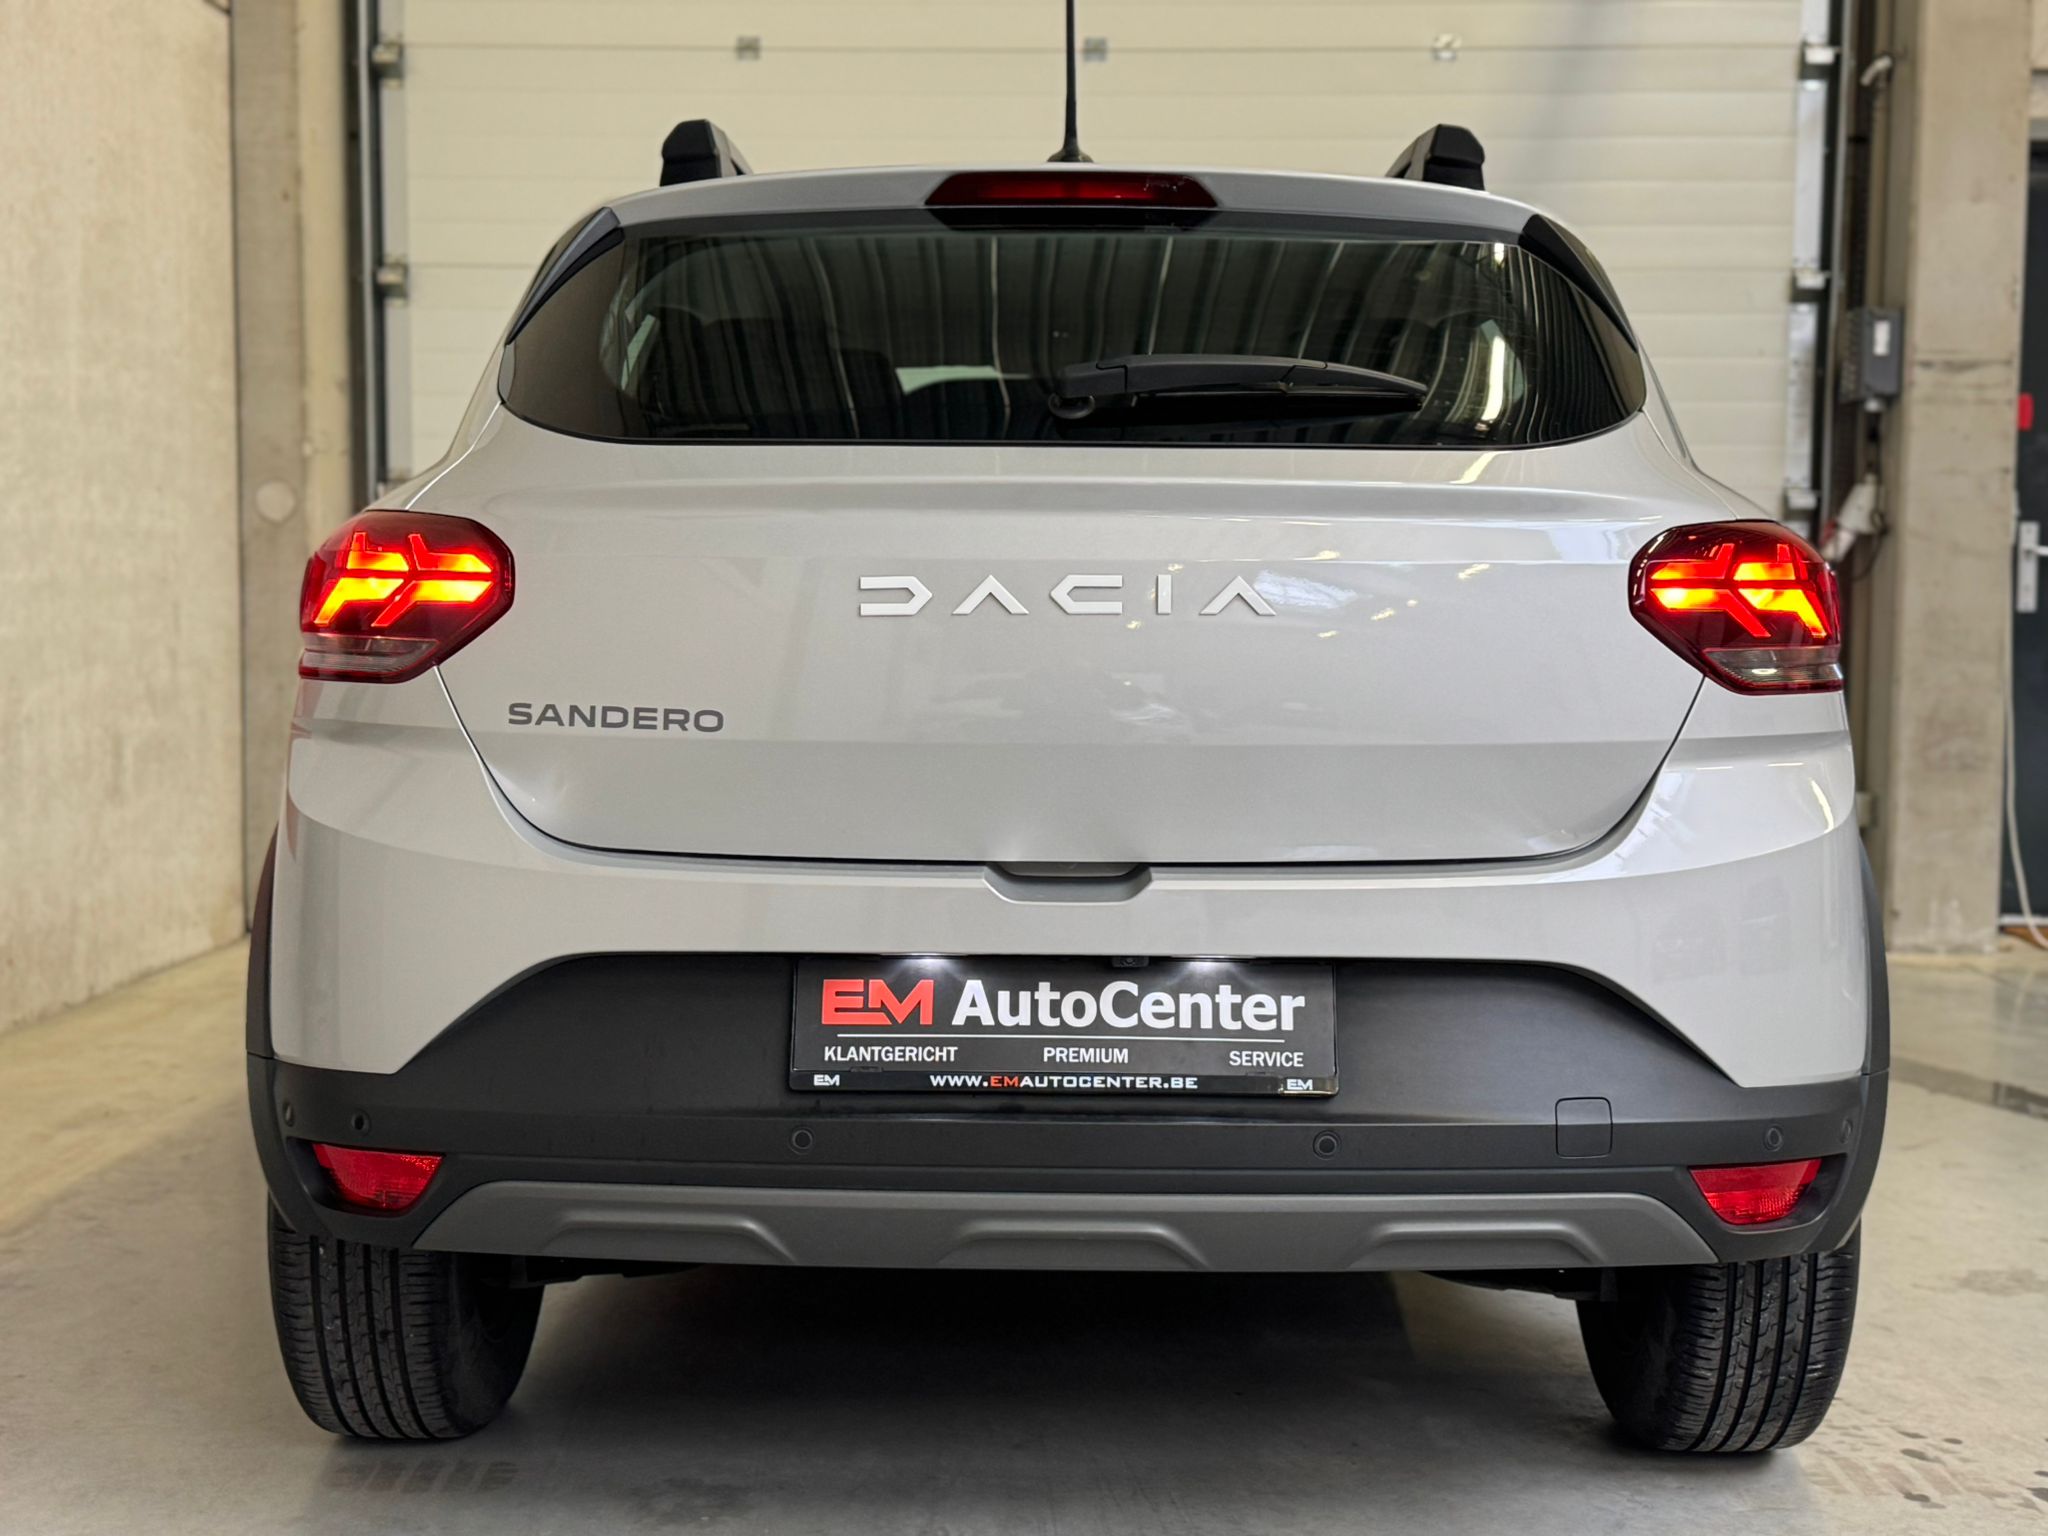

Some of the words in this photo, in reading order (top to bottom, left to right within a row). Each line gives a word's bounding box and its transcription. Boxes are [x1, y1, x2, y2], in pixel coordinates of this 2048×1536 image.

[858, 574, 1277, 617] DACIA
[507, 701, 725, 733] SANDERO
[821, 979, 934, 1025] EM
[951, 979, 1306, 1031] AutoCenter
[823, 1045, 959, 1064] KLANTGERICHT
[1042, 1046, 1130, 1065] PREMIUM
[1228, 1050, 1305, 1068] SERVICE
[813, 1074, 840, 1086] EM
[929, 1075, 1198, 1090] WWW.EMAUTOCENTER.BE
